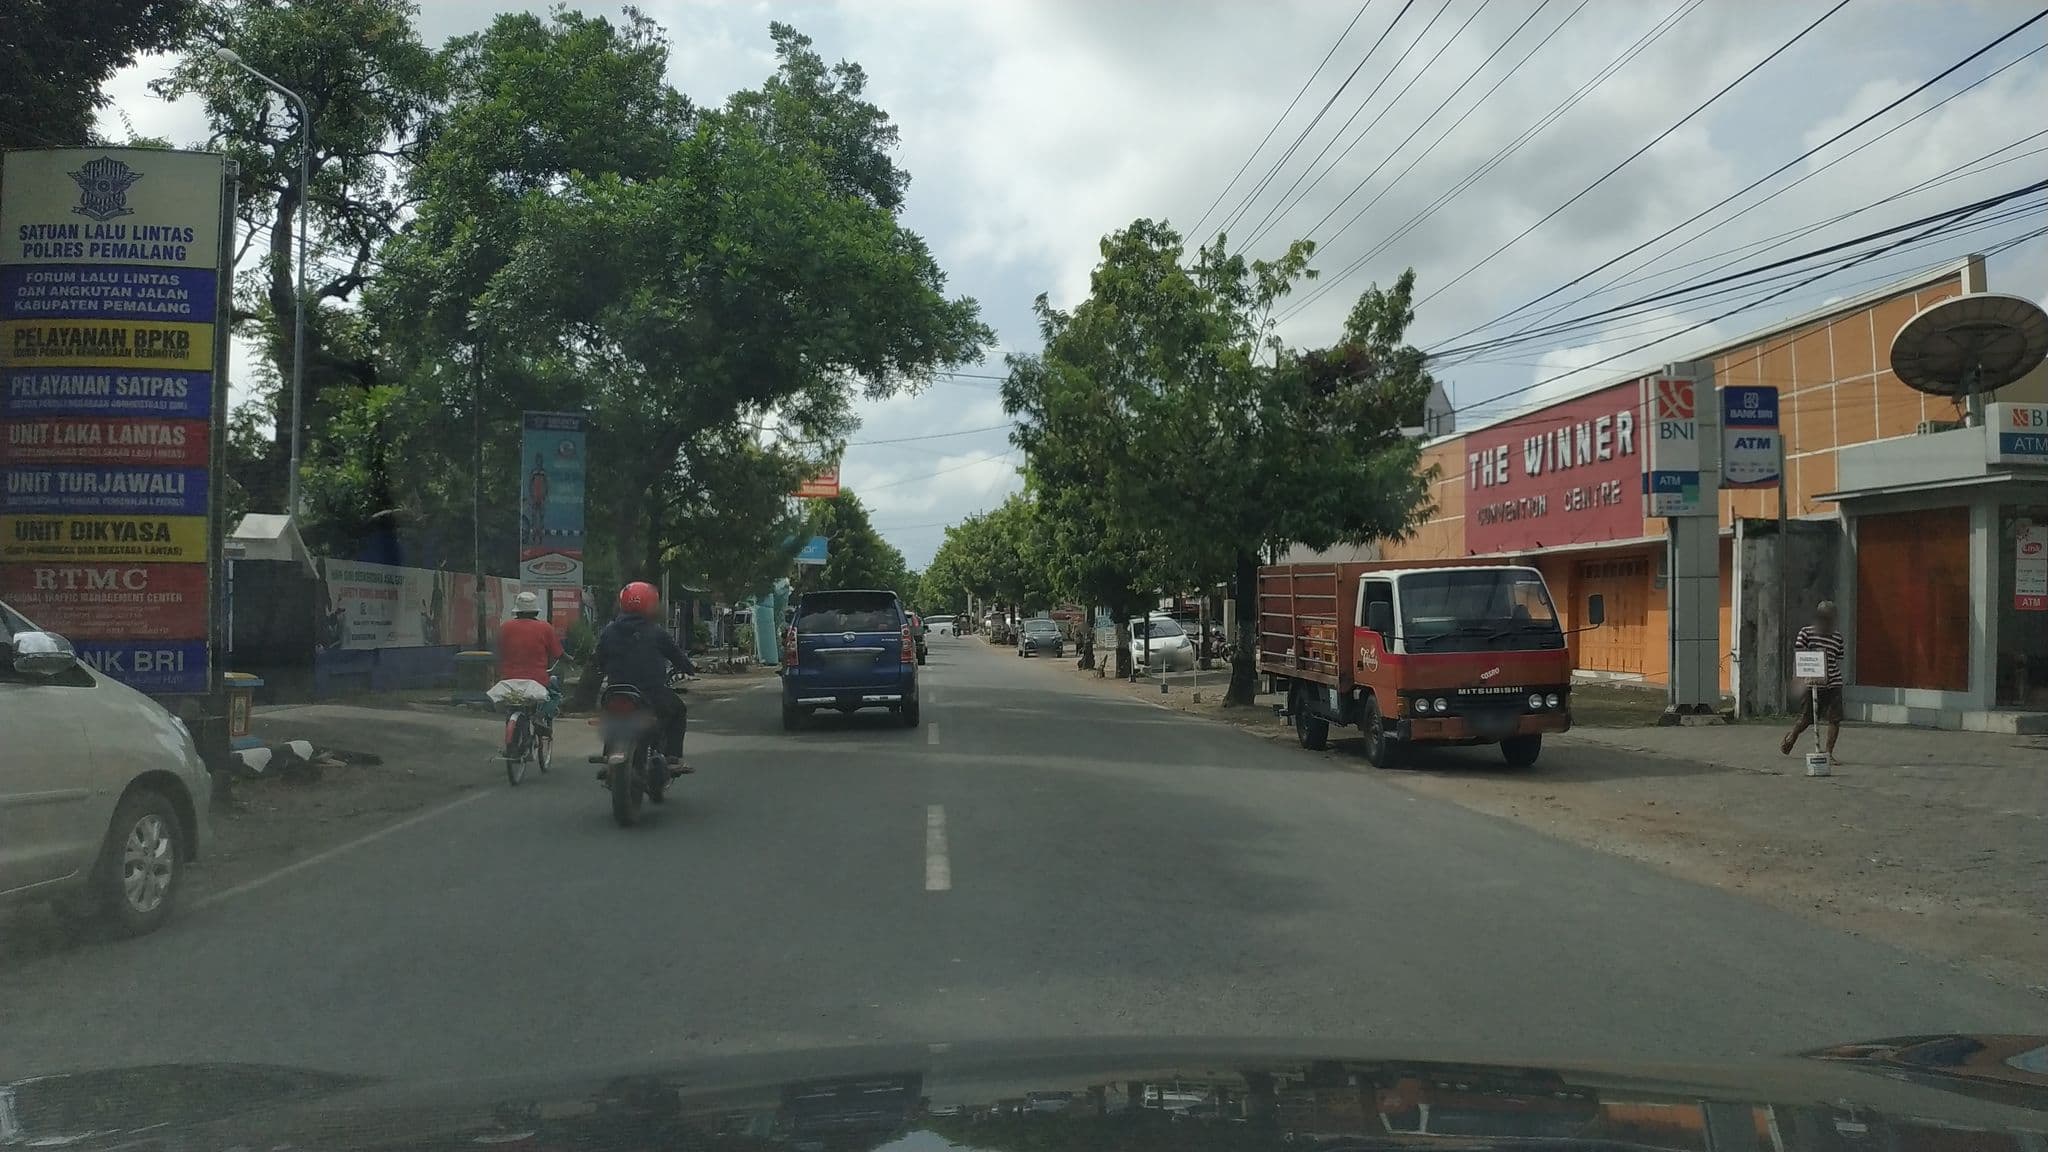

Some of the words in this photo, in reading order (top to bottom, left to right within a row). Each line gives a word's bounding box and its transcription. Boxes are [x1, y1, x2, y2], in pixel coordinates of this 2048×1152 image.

[19, 224, 79, 241] SATUAN
[85, 224, 126, 240] LALU
[132, 225, 194, 243] LINTAS
[22, 243, 84, 258] POLRES
[89, 243, 187, 261] PEMALANG
[26, 272, 76, 283] FORUM
[80, 273, 119, 283] LALU
[124, 273, 180, 286] LINTAS
[18, 286, 46, 297] DAN
[50, 287, 132, 298] ANGKUTAN
[137, 288, 189, 300] JALAN
[14, 299, 98, 311] KABUPATEN
[103, 300, 191, 314] PEMALANG
[14, 328, 127, 349] PELAYANAN
[134, 329, 190, 350] BPKB
[11, 376, 110, 396] PELAYANAN
[116, 377, 188, 398] SATPAS
[1730, 409, 1757, 419] BANK
[10, 425, 49, 445] UNIT
[54, 425, 101, 445] LAKA
[108, 425, 187, 446] LANTAS
[1660, 422, 1695, 440] BNI
[1468, 445, 1510, 490] THE
[1523, 410, 1636, 476] WINNER
[1734, 437, 1771, 449] ATM
[2014, 437, 2048, 452] ATM
[8, 472, 51, 493] UNIT
[57, 471, 185, 494] TURJAWALI
[1659, 475, 1681, 486] ATM
[1564, 479, 1622, 512] CENTRE
[15, 520, 63, 542] UNIT
[70, 520, 171, 542] DIKYASA
[33, 569, 149, 590] RTMC
[81, 592, 145, 603] MANAGEMENT
[147, 592, 183, 603] CENTER
[2021, 598, 2041, 607] ATM
[83, 651, 125, 673] NK
[134, 650, 184, 672] BRI
[1458, 686, 1523, 695] MITSUBISHI
